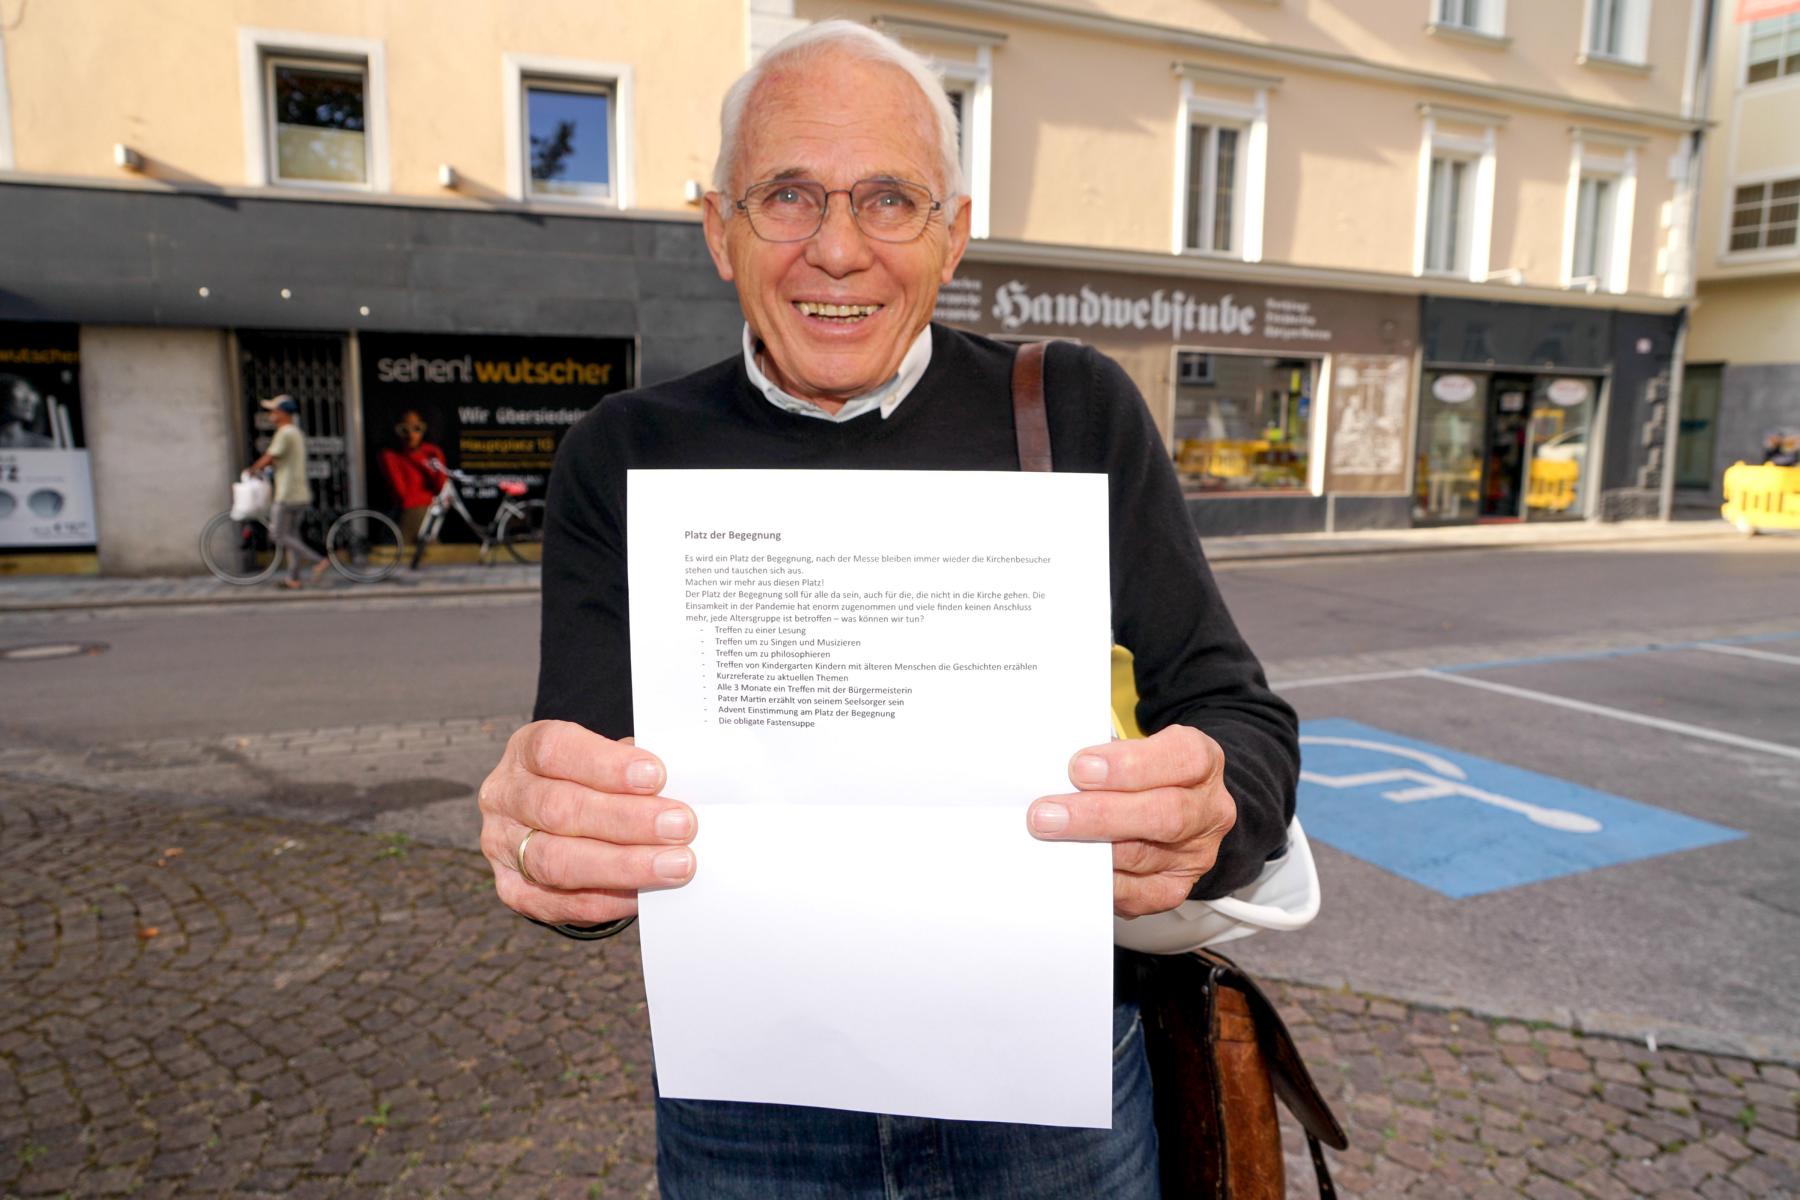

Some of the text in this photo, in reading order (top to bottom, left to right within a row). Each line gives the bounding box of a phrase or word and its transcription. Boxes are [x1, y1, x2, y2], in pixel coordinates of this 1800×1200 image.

[474, 356, 613, 385] wutscher
[458, 406, 490, 424] Wir
[684, 531, 782, 542] Platz der Begegnung
[684, 554, 1051, 564] Es wird ein Platz der Begegnung, nach der Messe bleiben immer wieder die Kirchenbesucher
[684, 566, 712, 574] stehen
[713, 566, 730, 574] und
[731, 566, 768, 574] tauschen
[769, 566, 786, 575] sich
[685, 578, 718, 586] Machen
[719, 578, 733, 586] wir
[734, 578, 756, 586] mehr
[773, 578, 800, 587] diesen
[801, 579, 825, 587] Platz!
[685, 590, 1046, 601] Der Platz der Begegnung soll für alle da sein, auch für die, die nicht in die Kirche gehen. Die
[685, 602, 729, 610] Einsamkeit
[730, 602, 738, 610] in
[739, 602, 754, 610] der
[755, 602, 796, 610] Pandemie
[796, 602, 811, 610] hat
[841, 604, 897, 612] zugenommen
[898, 603, 914, 611] und
[915, 603, 936, 611] viele
[937, 603, 963, 611] finden
[964, 603, 992, 611] keinen
[993, 603, 1032, 611] Anschluss
[685, 614, 709, 624] mehr,
[710, 614, 728, 624] jede
[729, 614, 781, 624] Altersgruppe
[782, 614, 793, 622] ist
[794, 614, 832, 622] betroffen
[858, 615, 889, 623] können
[890, 615, 904, 623] wir
[905, 615, 925, 623] tun?
[714, 626, 743, 634] Treffen
[755, 626, 777, 635] einer
[778, 627, 807, 637] Lesung
[714, 638, 743, 646] Treffen
[770, 638, 798, 648] Singen
[799, 638, 815, 646] und
[816, 638, 861, 647] Musizieren
[715, 649, 744, 657] Treffen
[770, 650, 831, 660] philosophieren
[715, 661, 744, 669] Treffen
[761, 661, 813, 671] Kindergarten
[815, 661, 847, 670] Kindern
[848, 662, 862, 670] mit
[863, 662, 893, 670] älteren
[894, 662, 937, 670] Menschen
[938, 662, 951, 670] die
[952, 662, 1002, 671] Geschichten
[1003, 663, 1038, 671] erzählen
[716, 672, 765, 681] Kurzreferate
[777, 673, 815, 681] aktuellen
[815, 674, 849, 682] Themen
[716, 683, 913, 697] Alle 3 Monate ein Treffen mit der Bürgermeisterin
[717, 694, 739, 703] Pater
[740, 695, 767, 703] Martin
[768, 695, 796, 704] erzählt
[813, 696, 843, 705] seinem
[844, 697, 887, 708] Seelsorger
[888, 698, 905, 707] sein
[718, 706, 746, 714] Advent
[747, 706, 799, 717] Einstimmung
[814, 708, 834, 716] Platz
[835, 708, 850, 717] der
[851, 709, 896, 720] Begegnung
[718, 717, 816, 730] Die obligate Fastensuppe
